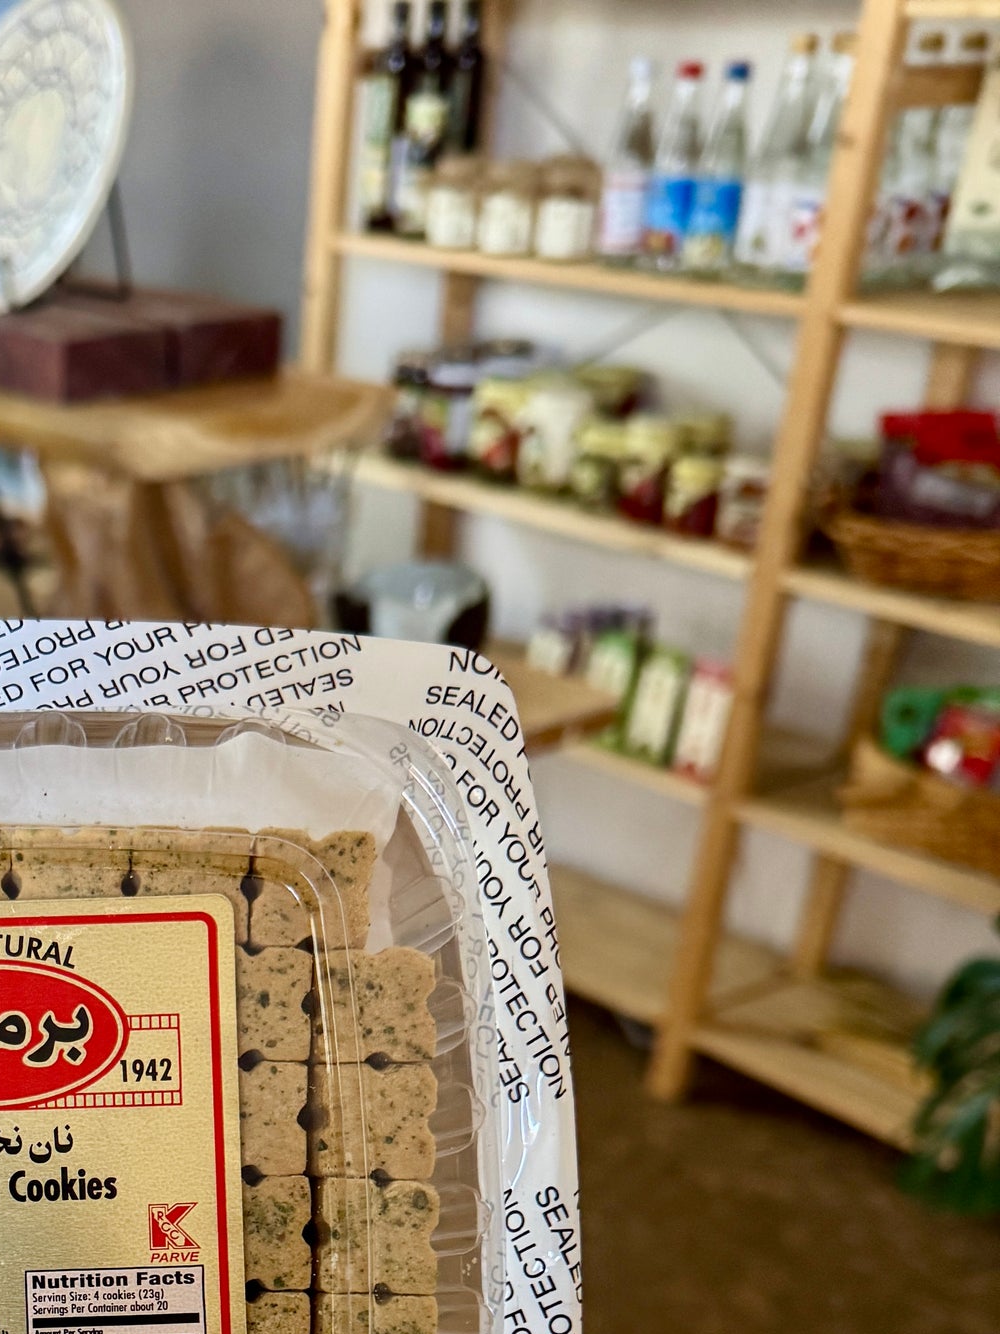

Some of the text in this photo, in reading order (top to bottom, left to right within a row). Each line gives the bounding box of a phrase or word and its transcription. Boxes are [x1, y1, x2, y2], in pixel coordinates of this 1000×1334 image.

[94, 626, 178, 666] YOUR
[178, 634, 362, 705] PROTECTION
[425, 685, 518, 742] SEALED
[456, 770, 500, 826] FOR
[120, 1058, 173, 1083] 1942
[29, 1124, 73, 1164] نان
[9, 1167, 117, 1202] Cookies
[150, 1251, 200, 1263] PARVE
[32, 1271, 195, 1289] Nutrition Facts
[32, 1288, 164, 1304] Serving Size: 4 cookies (23g)
[33, 1300, 168, 1316] Servings Per Container about 20
